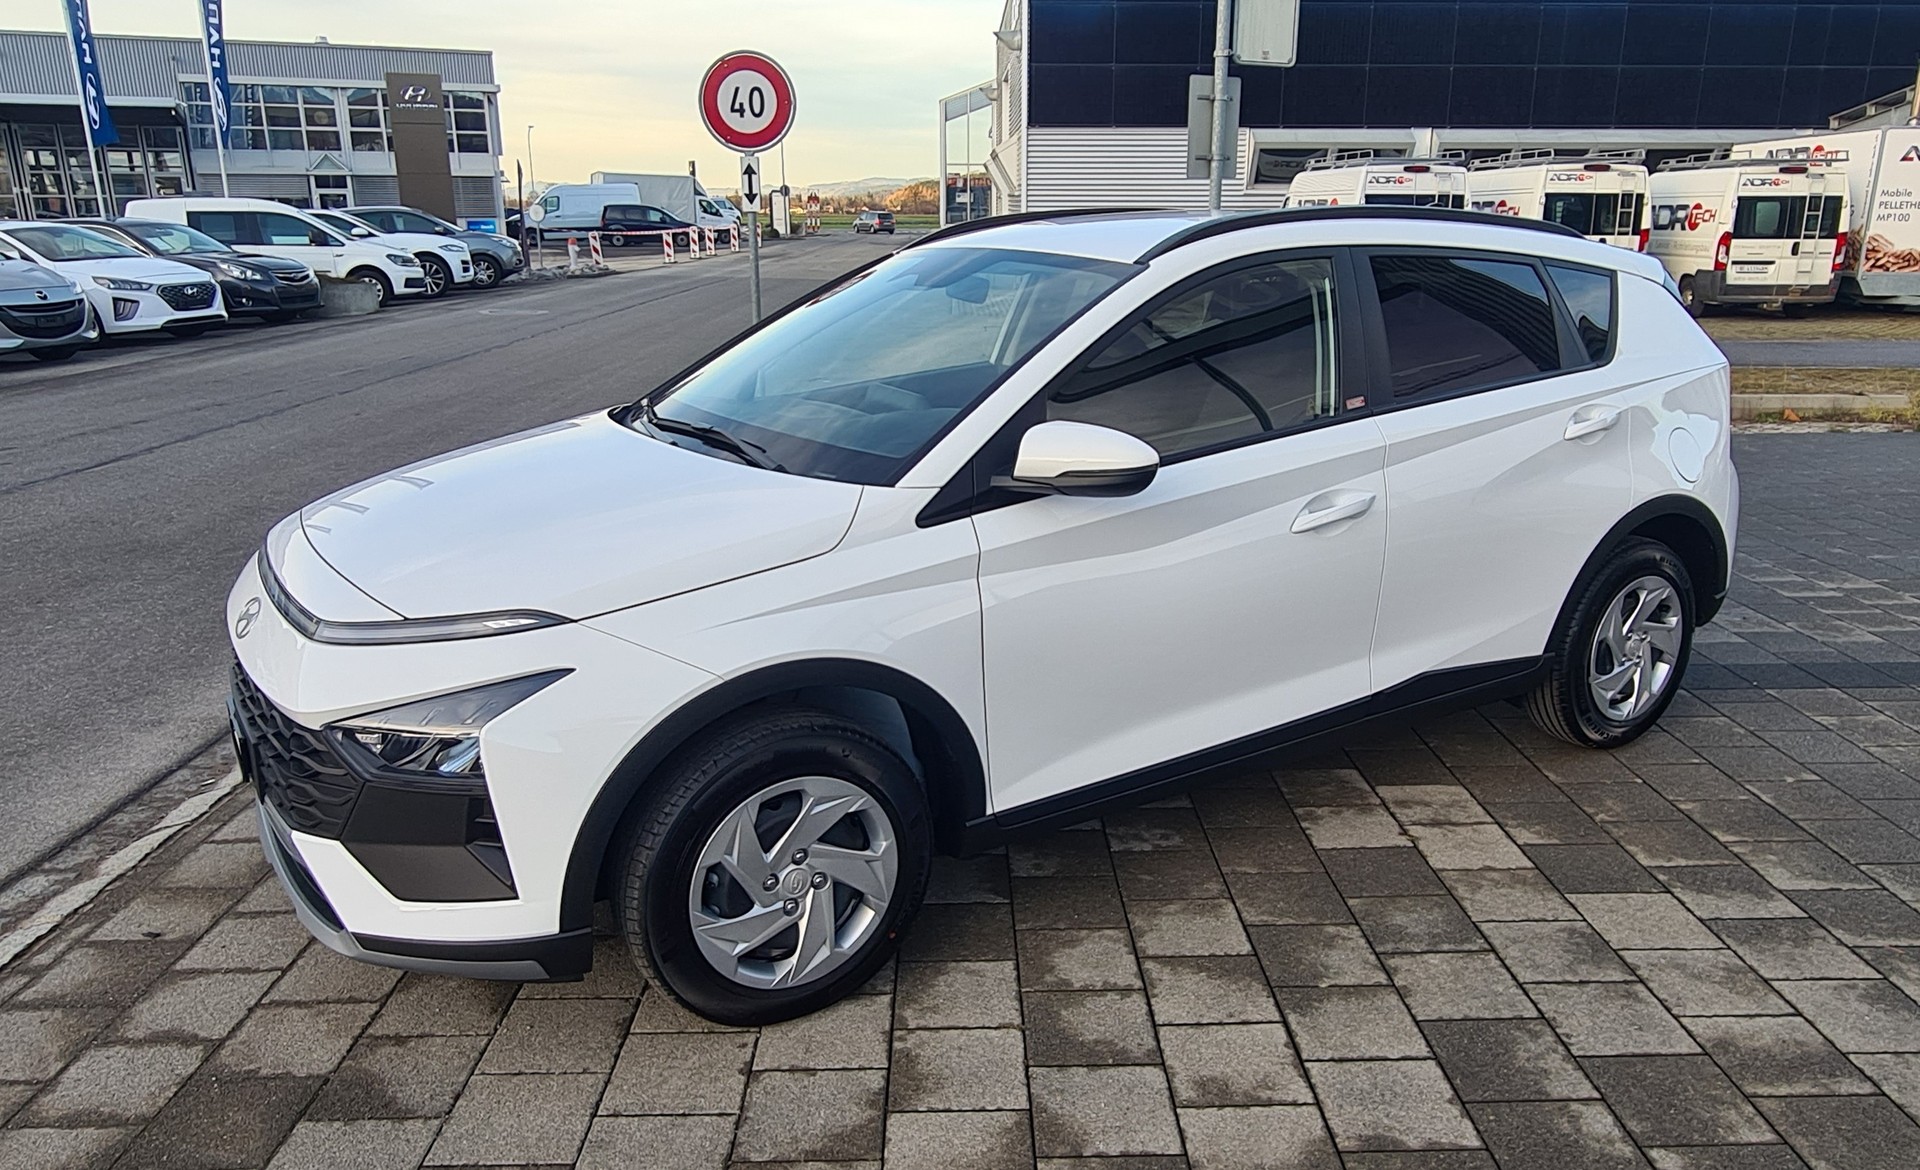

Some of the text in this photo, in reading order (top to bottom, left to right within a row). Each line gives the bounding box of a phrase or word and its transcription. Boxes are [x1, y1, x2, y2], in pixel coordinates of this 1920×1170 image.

[730, 86, 765, 118] 40
[1880, 188, 1912, 197] Mobile
[1876, 213, 1910, 222] MP100
